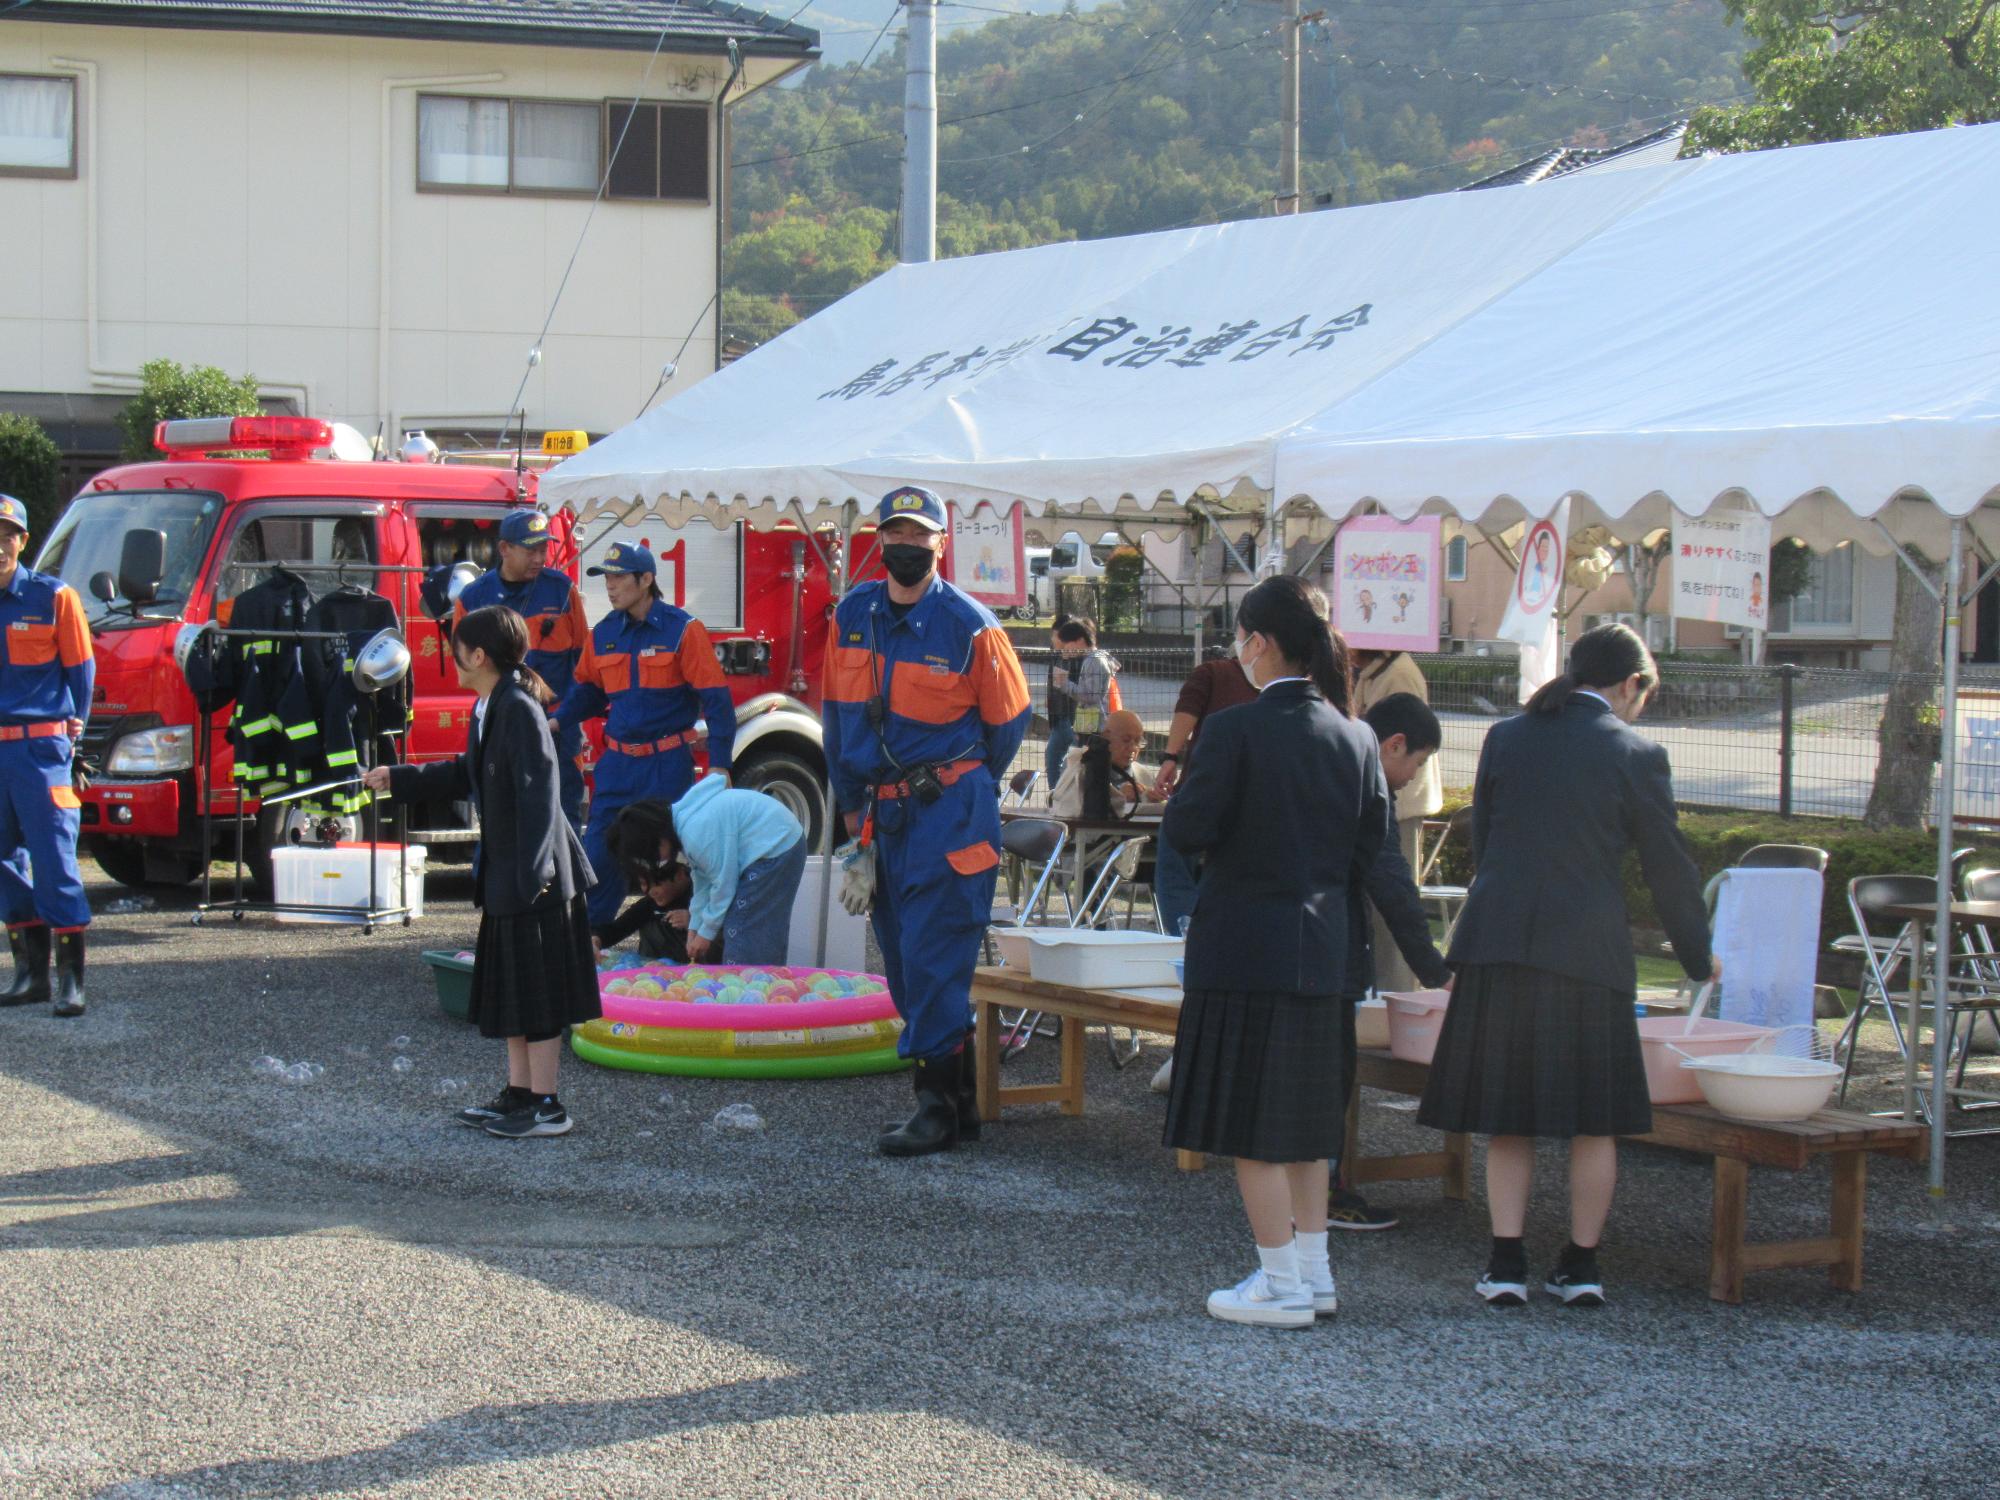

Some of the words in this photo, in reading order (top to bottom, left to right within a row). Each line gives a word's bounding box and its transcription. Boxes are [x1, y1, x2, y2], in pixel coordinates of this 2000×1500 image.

[956, 521, 1007, 537] ヨーヨーつり
[640, 538, 686, 608] 1
